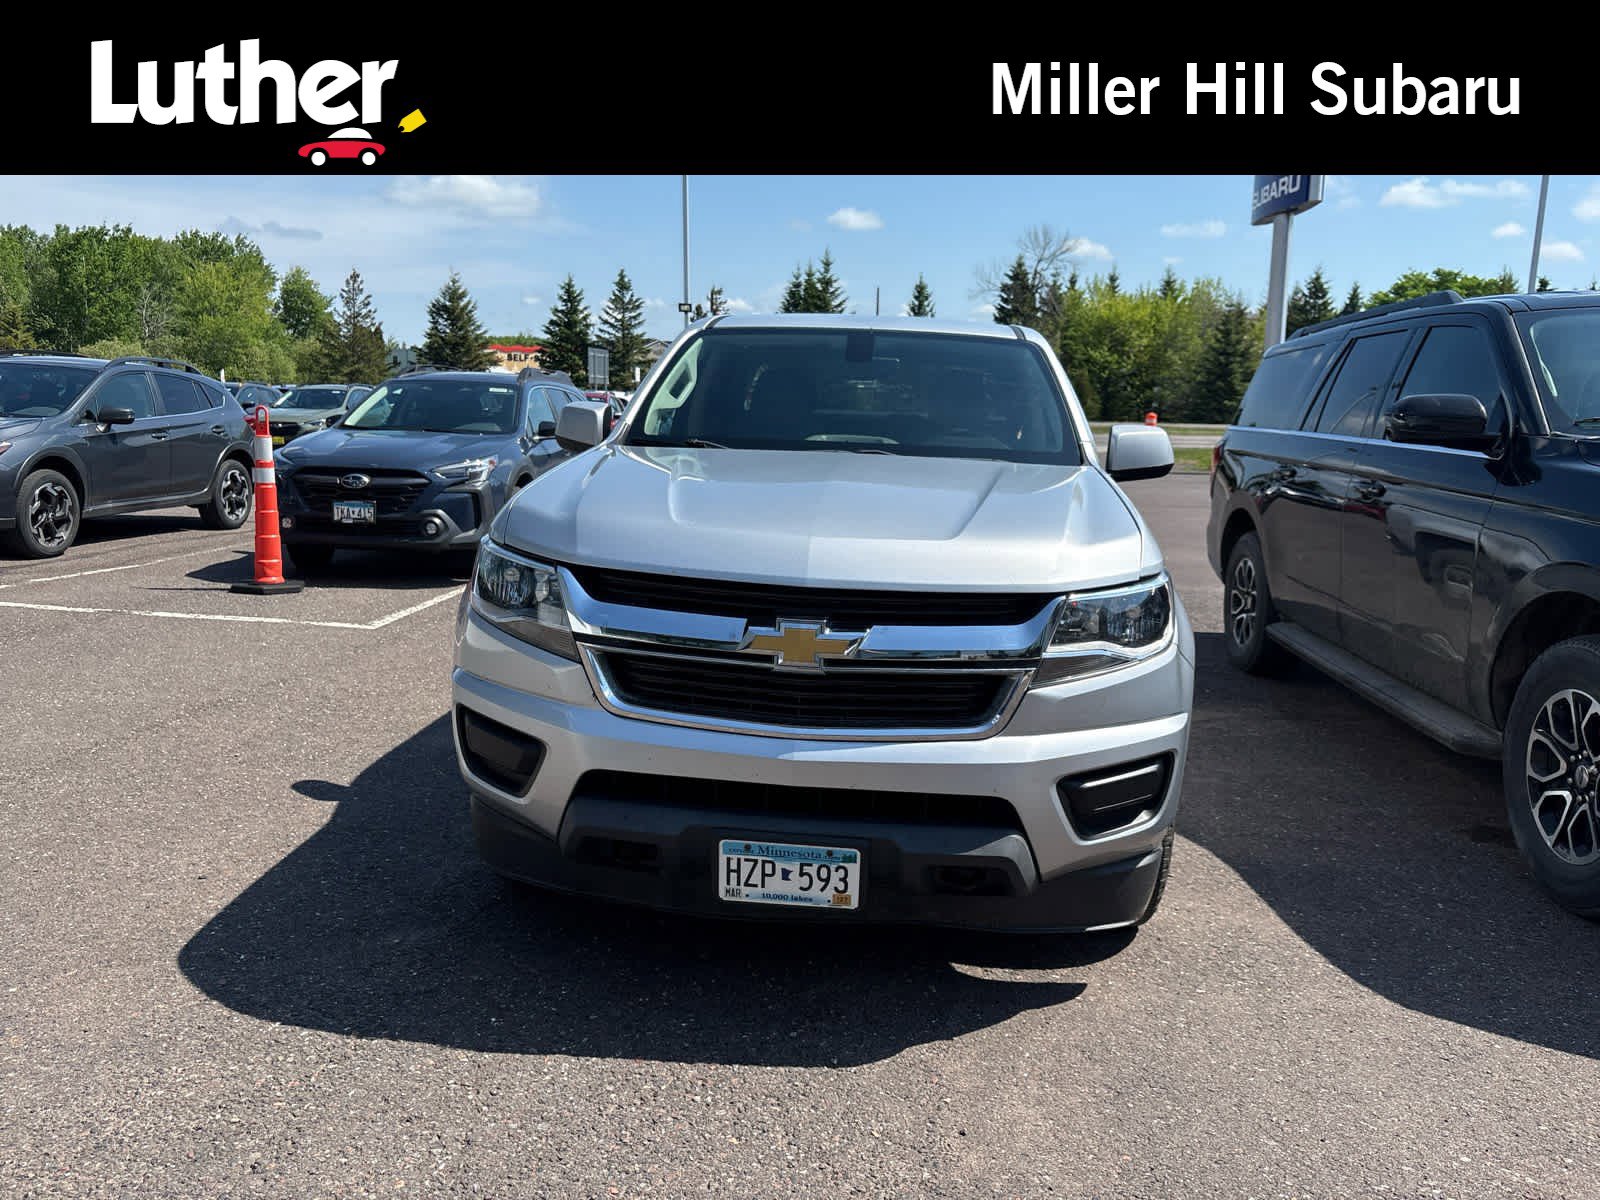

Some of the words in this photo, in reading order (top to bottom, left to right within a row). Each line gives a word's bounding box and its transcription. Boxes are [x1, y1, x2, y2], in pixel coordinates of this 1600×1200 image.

[1252, 175, 1302, 210] SUBARU
[758, 845, 822, 859] Minnesota
[726, 857, 776, 888] HZP
[799, 863, 849, 894] 593
[725, 887, 742, 898] MAR
[762, 892, 789, 901] 10,000
[791, 894, 813, 903] lakes
